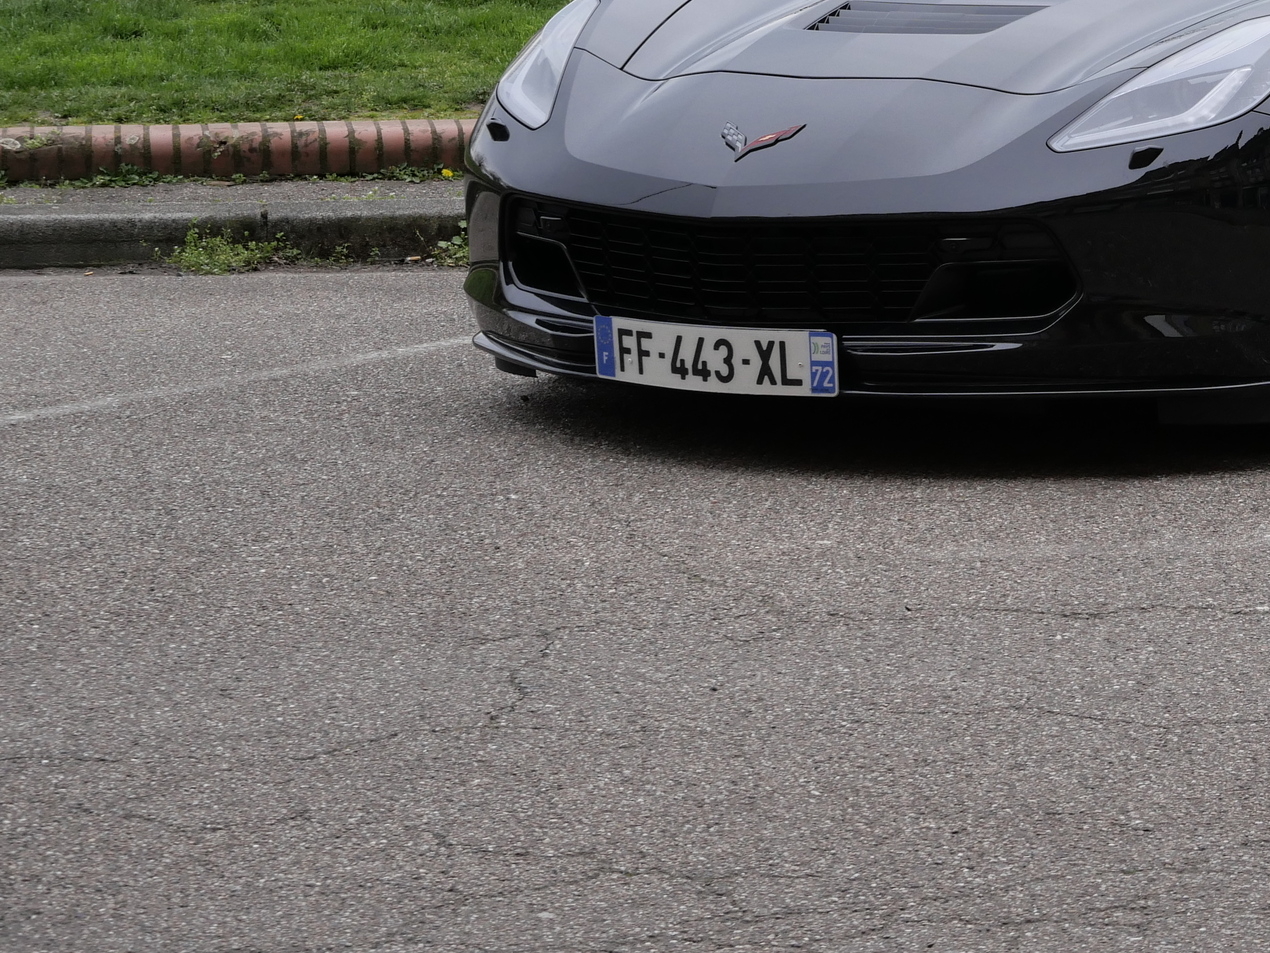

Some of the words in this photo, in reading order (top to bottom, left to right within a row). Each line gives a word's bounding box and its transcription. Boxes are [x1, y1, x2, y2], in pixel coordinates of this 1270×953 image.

[602, 352, 608, 364] F
[617, 328, 803, 387] FF-443-XL
[811, 365, 833, 387] 72
